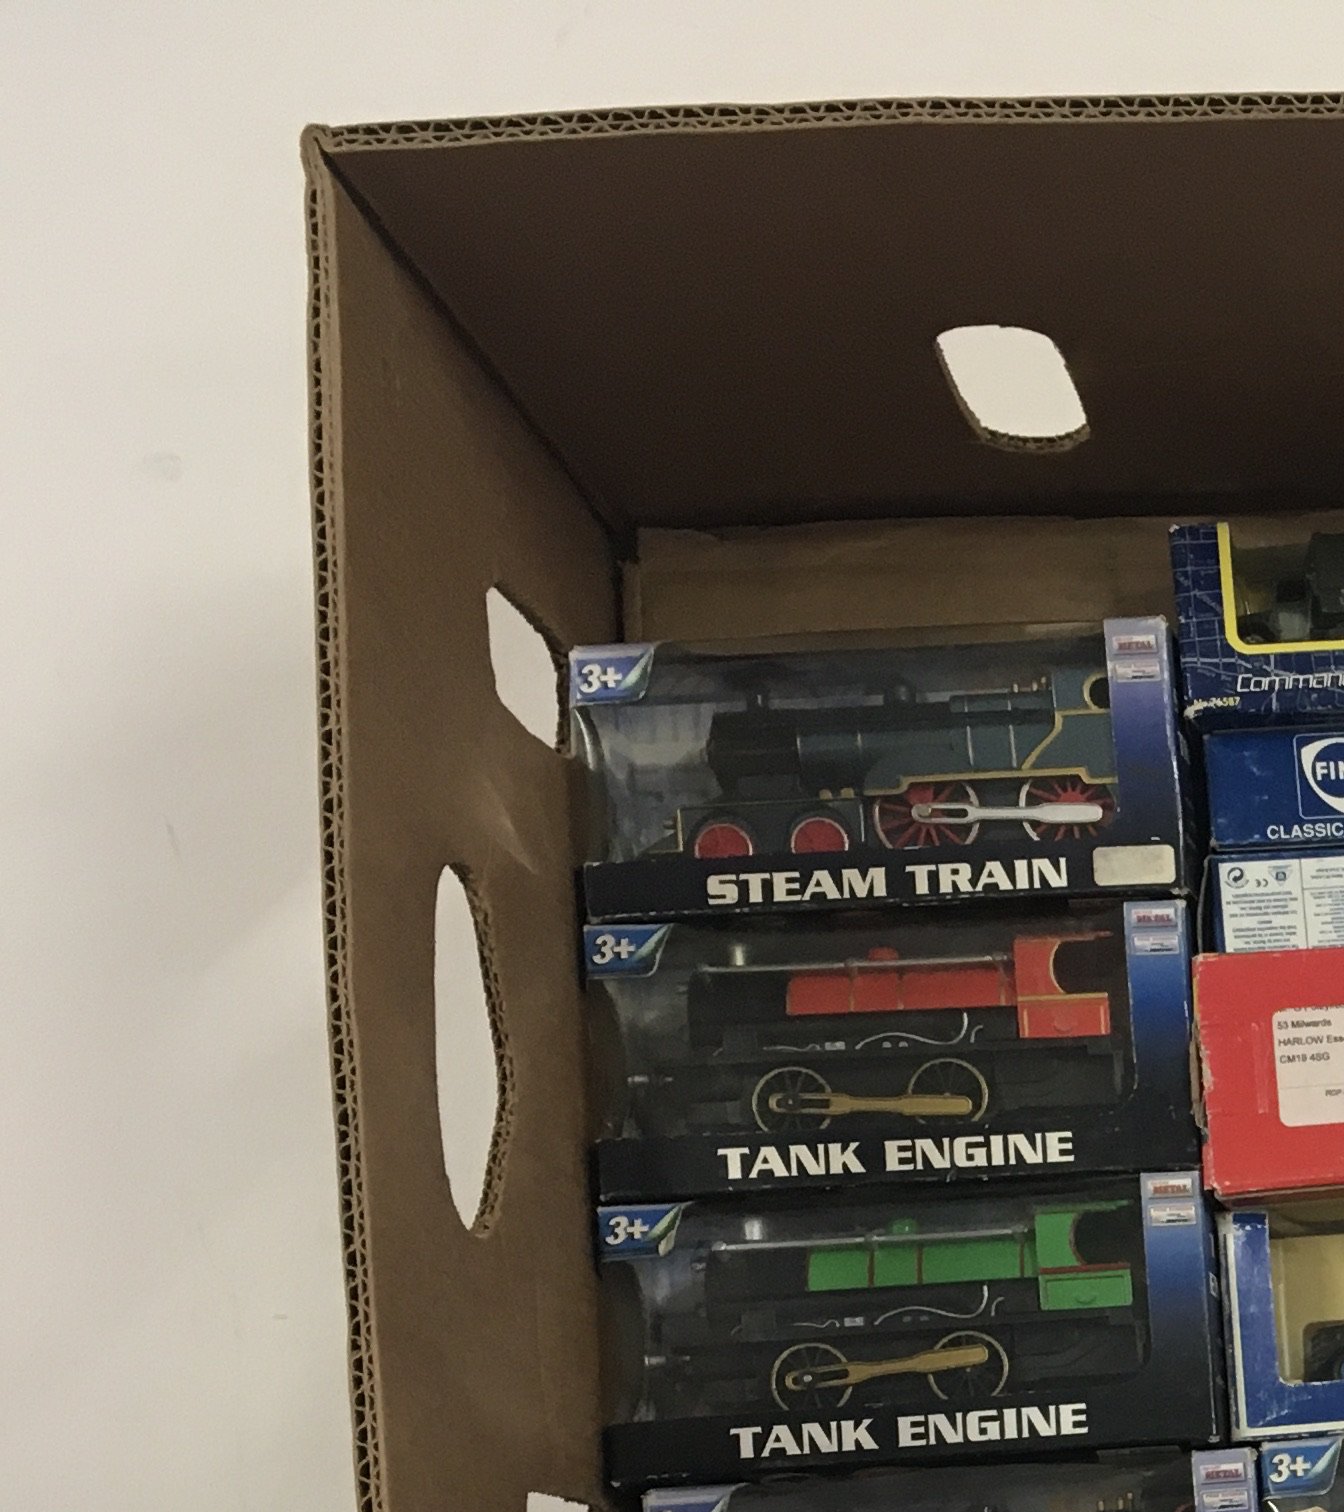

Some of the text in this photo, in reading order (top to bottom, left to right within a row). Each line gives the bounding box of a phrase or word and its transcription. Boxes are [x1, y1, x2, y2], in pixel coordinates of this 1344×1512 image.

[578, 664, 622, 693] 3+
[1266, 822, 1344, 840] CLASSIC
[707, 856, 1067, 904] STEAM TRAIN
[592, 934, 636, 966] 3+
[1278, 1035, 1324, 1047] HARLOW
[718, 1131, 1074, 1180] TANK ENGINE
[604, 1215, 650, 1246] 3+
[730, 1402, 1089, 1459] TANK ENGINE
[1268, 1452, 1312, 1483] 3+
